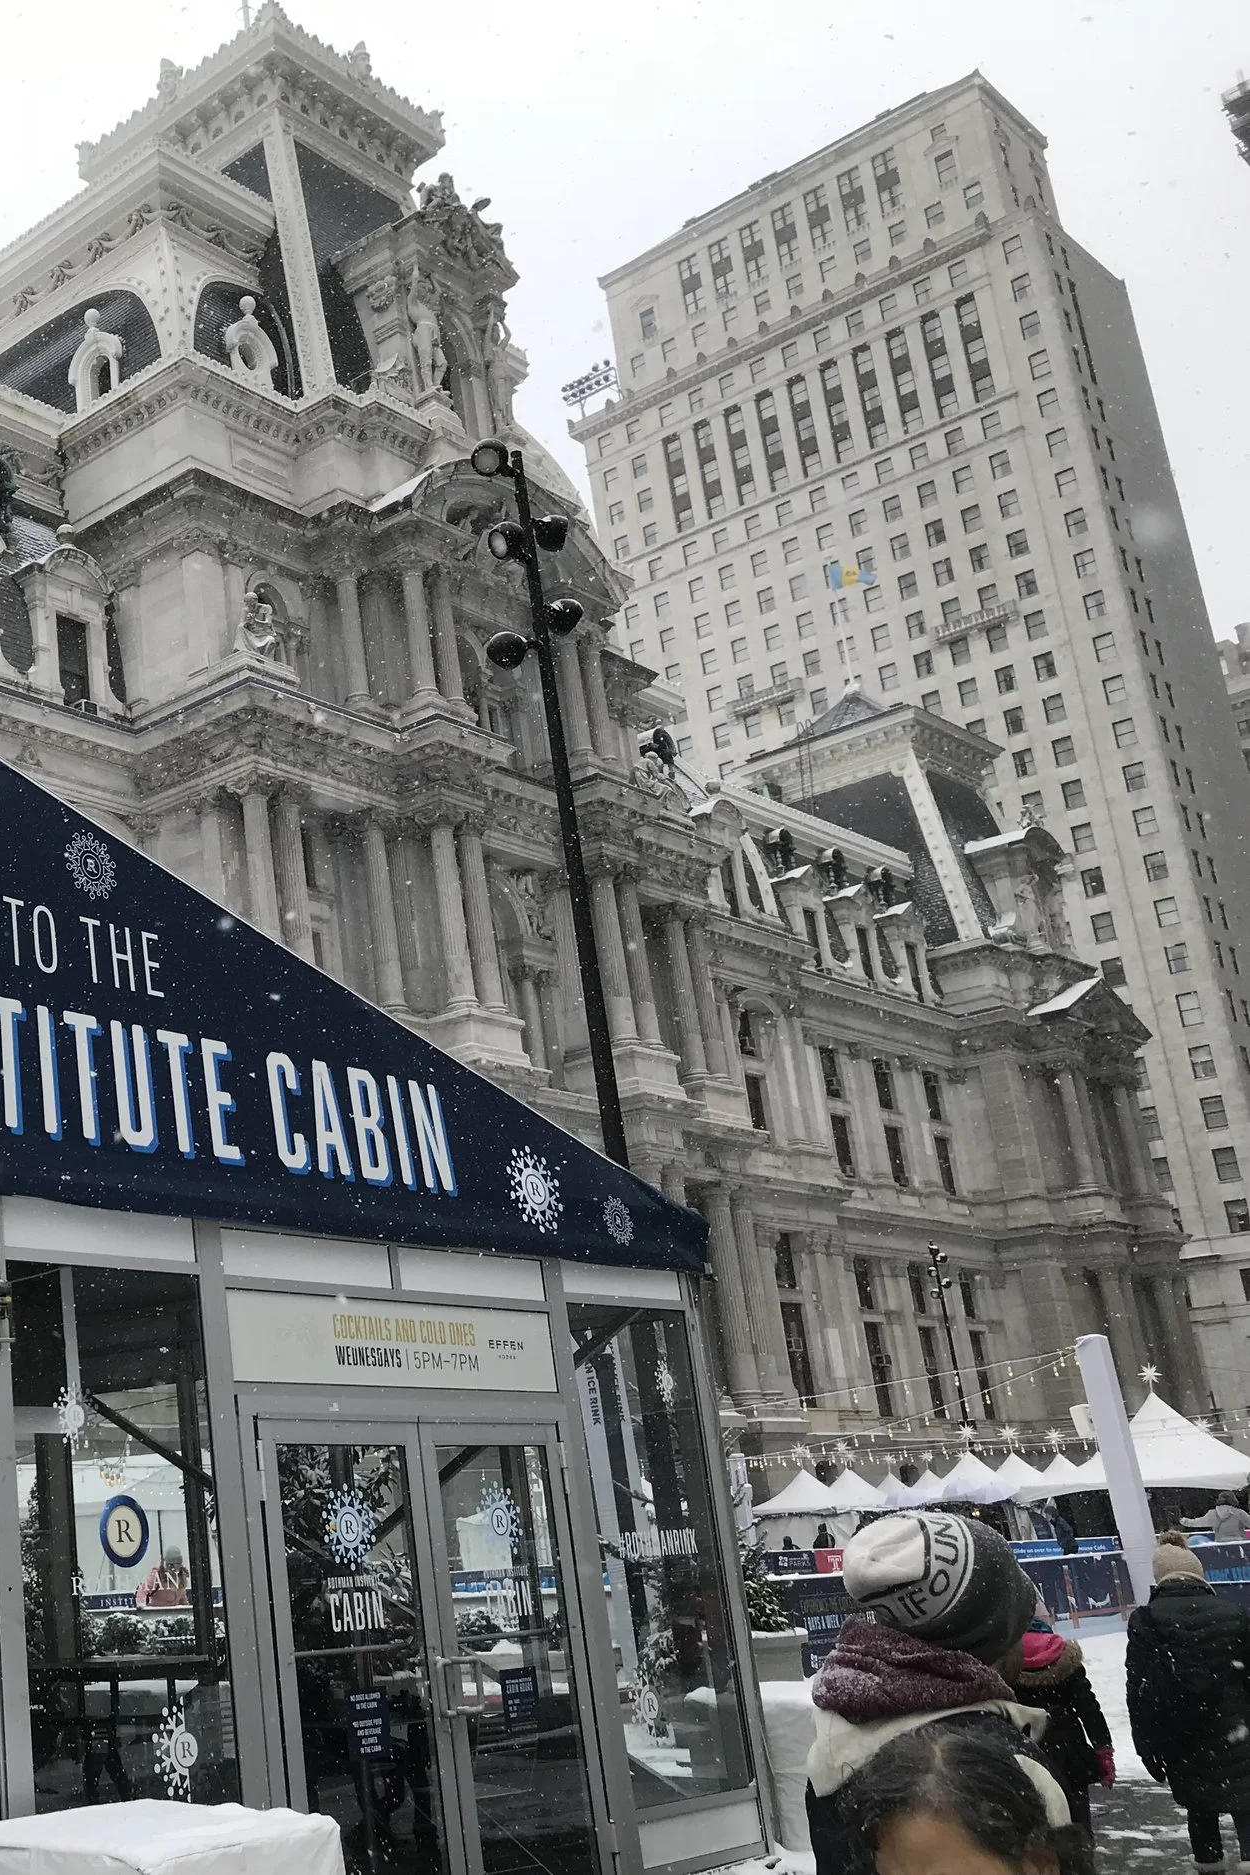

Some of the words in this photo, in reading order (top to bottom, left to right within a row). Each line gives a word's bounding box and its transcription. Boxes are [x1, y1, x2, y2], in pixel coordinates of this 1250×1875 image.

[2, 895, 58, 975] TO
[78, 916, 165, 998] THE
[266, 1051, 457, 1197] CABIN
[332, 1313, 392, 1342] COCKTAILS
[395, 1317, 417, 1344] AND
[419, 1319, 446, 1346] COLD
[449, 1322, 476, 1347] ONES
[335, 1345, 402, 1369] WEDNESDAYS
[488, 1339, 524, 1351] EFFEN
[586, 1376, 598, 1395] ICE
[590, 1397, 602, 1426] RINK
[116, 1519, 135, 1543] R
[330, 1591, 386, 1633] CABIN
